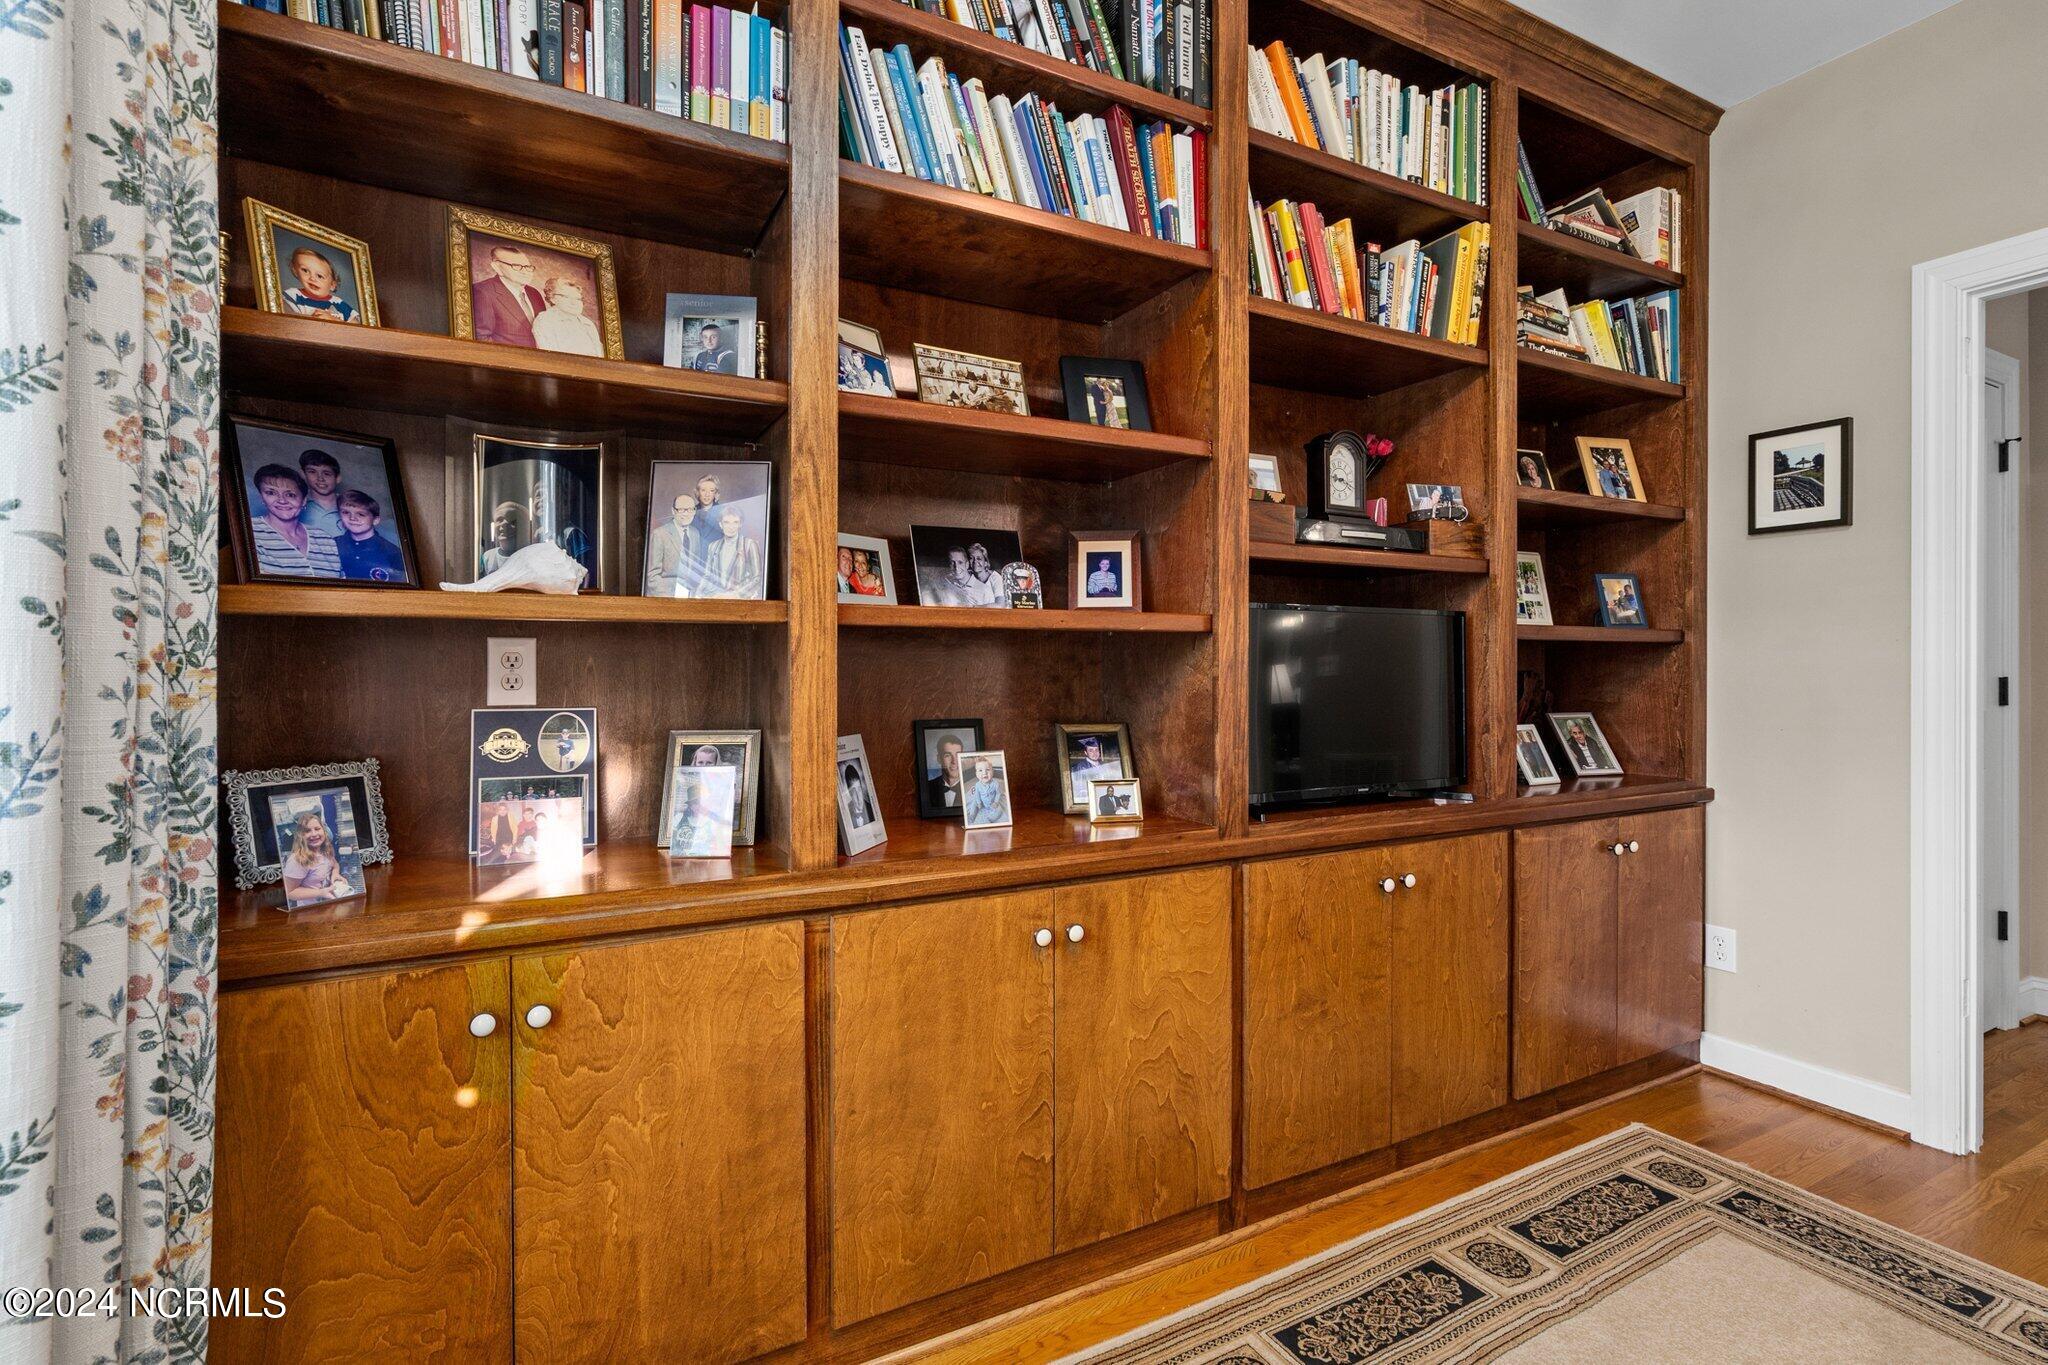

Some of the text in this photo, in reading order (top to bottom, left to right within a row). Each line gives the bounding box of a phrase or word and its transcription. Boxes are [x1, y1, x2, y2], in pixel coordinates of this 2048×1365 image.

[570, 26, 579, 48] Calling
[609, 7, 619, 37] Calling
[1130, 14, 1140, 56] Namath
[853, 34, 865, 56] Eat,
[1099, 26, 1117, 65] CRAMER
[1182, 14, 1191, 80] Ted Turner
[860, 58, 875, 91] Drink
[871, 98, 881, 112] Be
[915, 95, 923, 113] Smart
[950, 77, 973, 136] DARING GREATLY
[874, 114, 892, 151] Happy
[1091, 144, 1105, 188] SOLUTION
[1122, 126, 1137, 166] HEALTH
[1130, 168, 1148, 216] SECRETS
[1145, 129, 1155, 174] UNCOMMON
[1150, 175, 1158, 200] CURES
[1579, 230, 1610, 248] SEASONS
